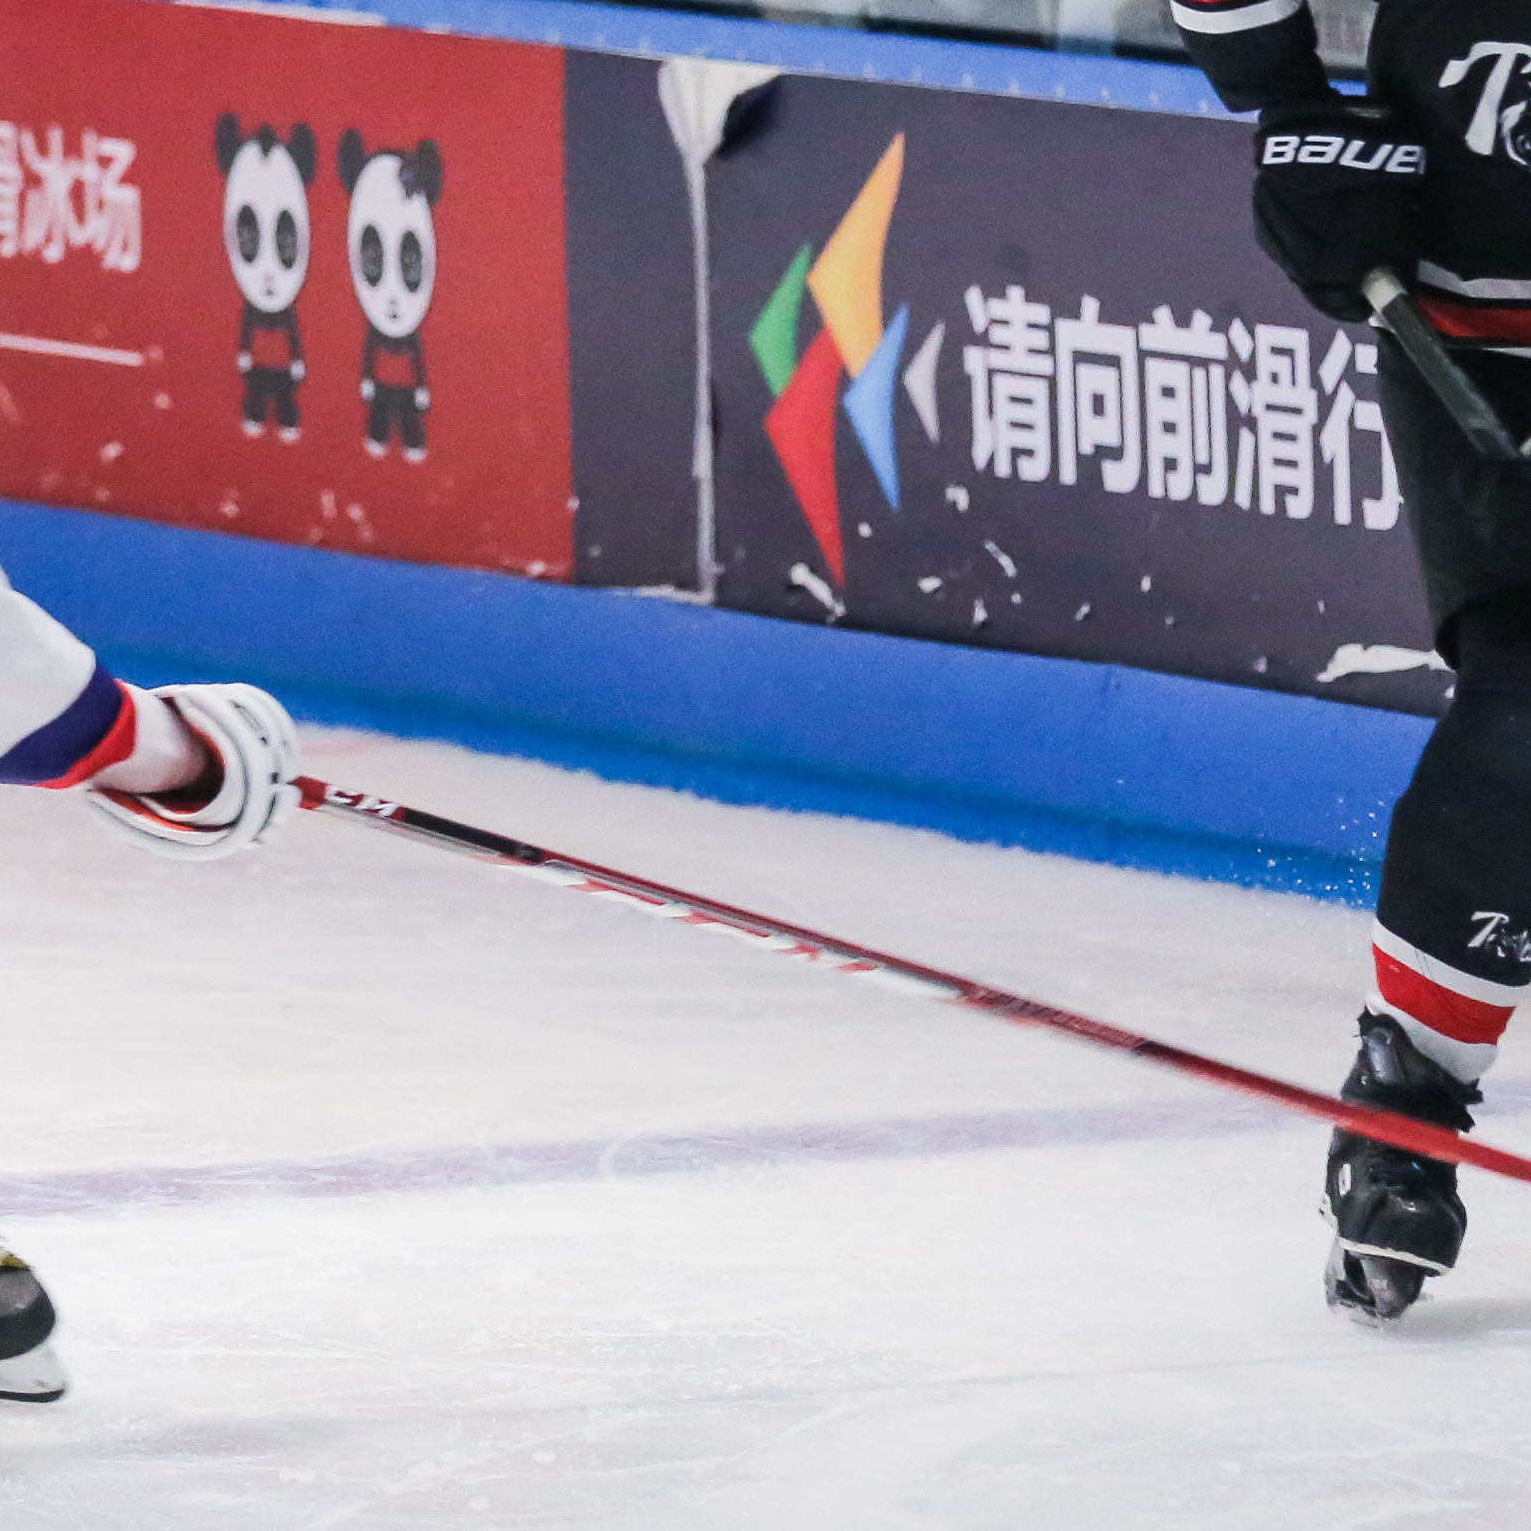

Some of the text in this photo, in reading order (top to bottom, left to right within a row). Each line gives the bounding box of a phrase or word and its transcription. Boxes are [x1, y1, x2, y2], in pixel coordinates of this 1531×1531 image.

[963, 284, 1403, 532] 请向前滑行
